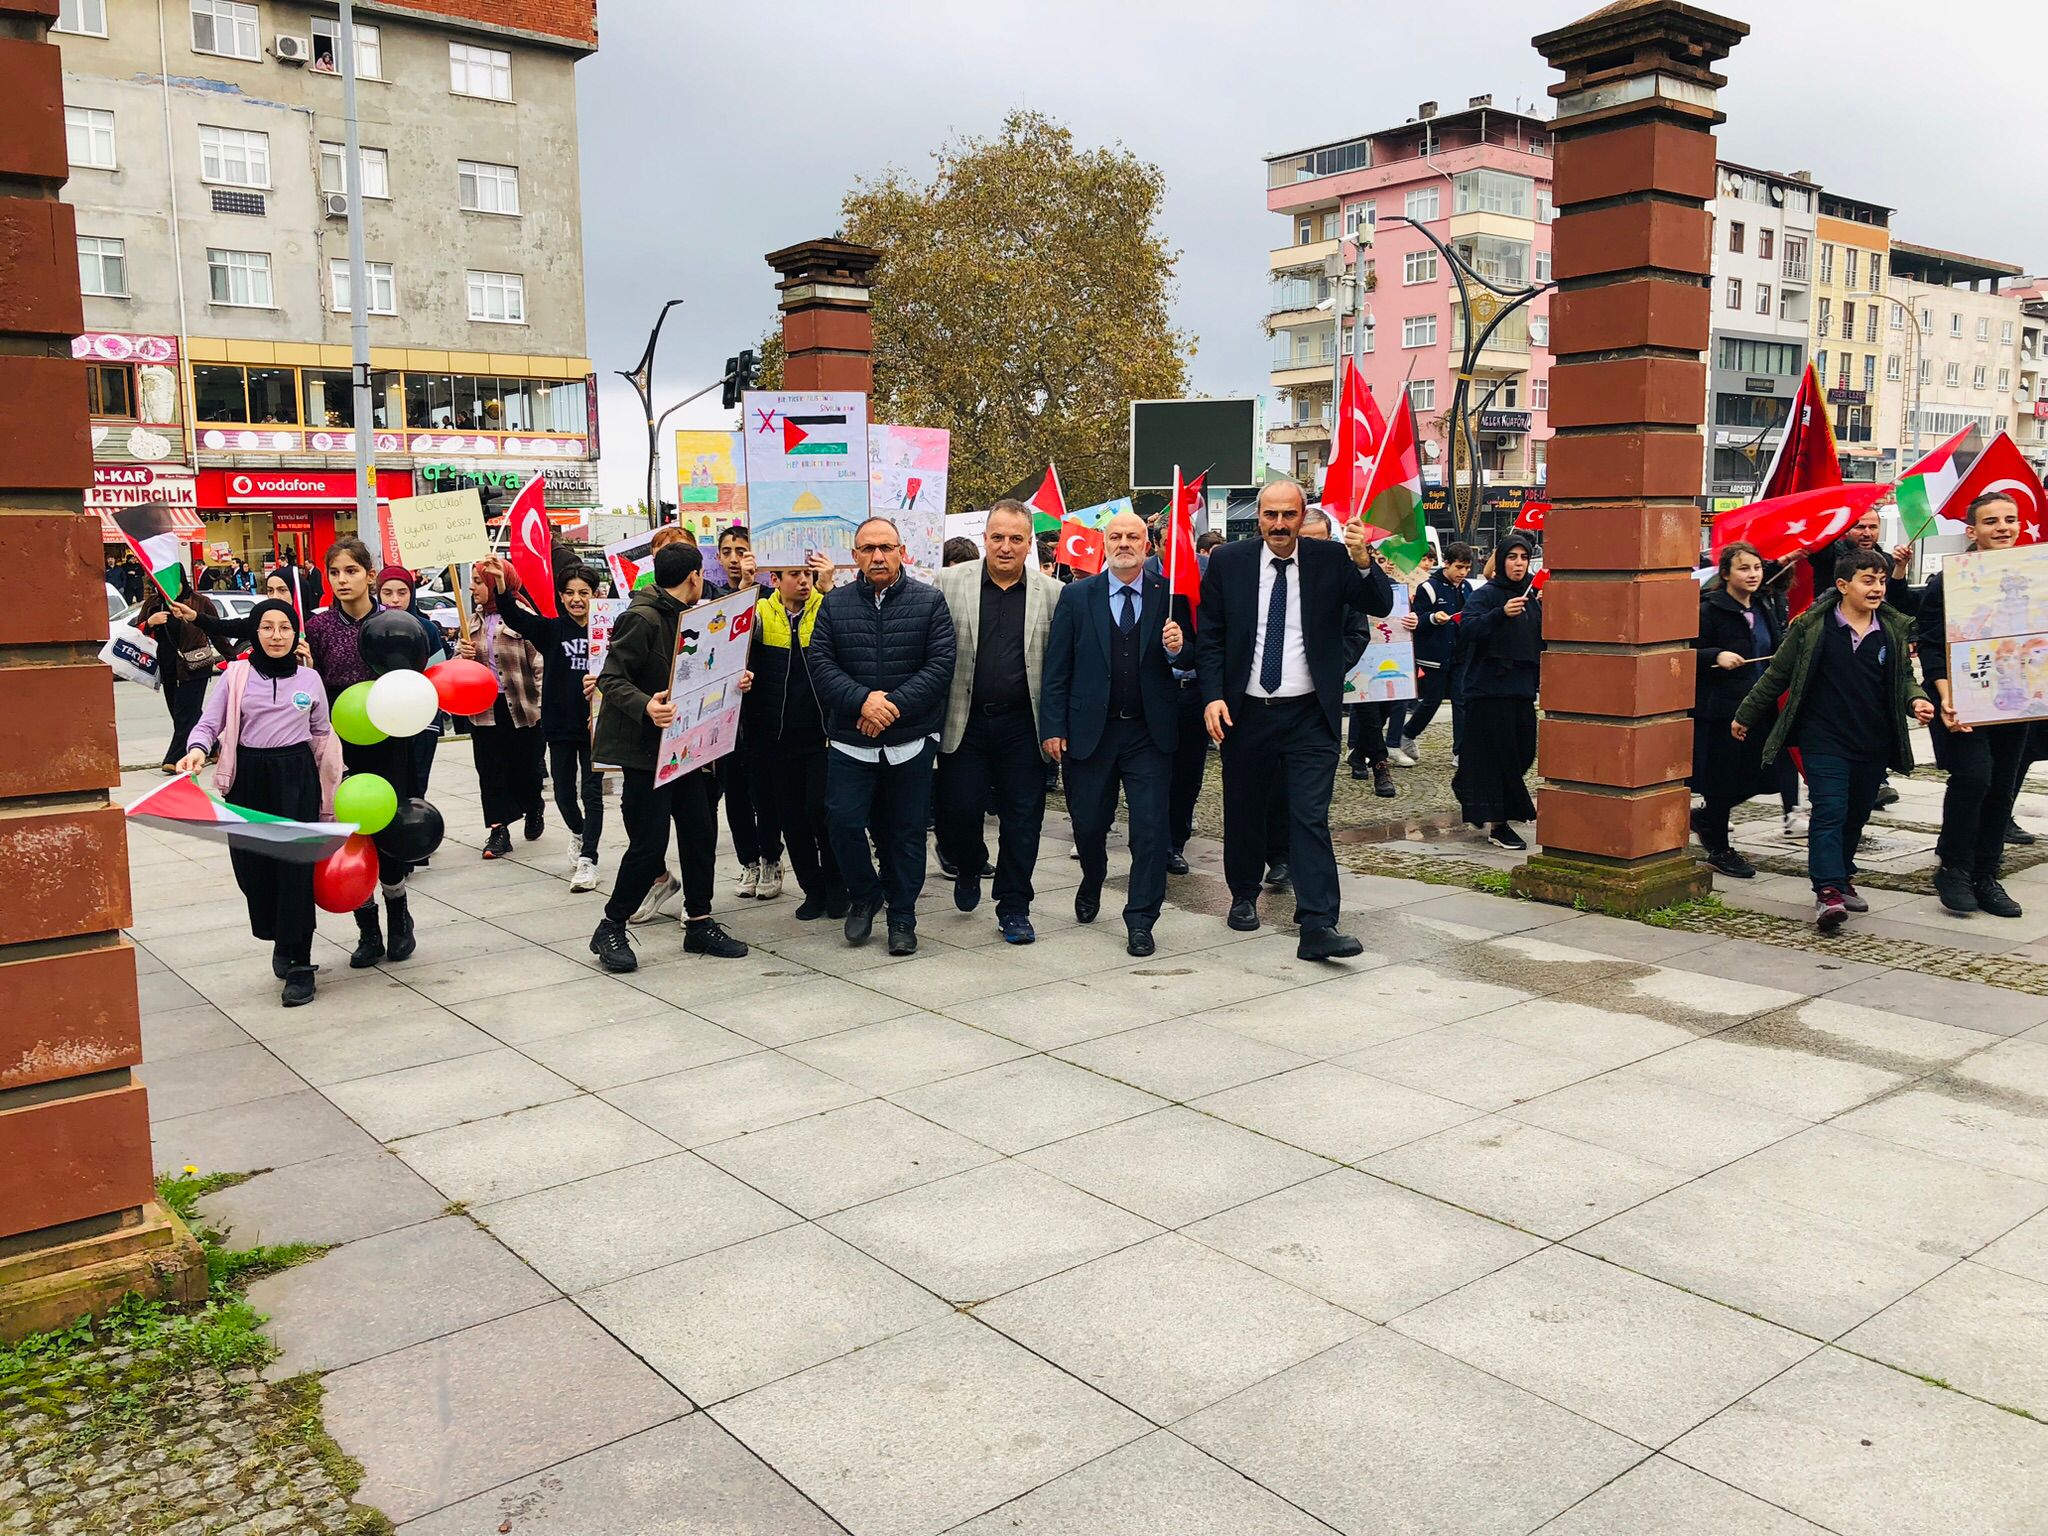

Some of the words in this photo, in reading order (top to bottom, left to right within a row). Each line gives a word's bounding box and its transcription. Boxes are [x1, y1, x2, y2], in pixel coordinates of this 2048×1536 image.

[94, 470, 147, 482] N-KAR
[569, 469, 580, 478] 66
[257, 478, 326, 491] vodafone
[525, 480, 592, 490] ANTACILIK
[92, 487, 193, 502] PEYNİRCİLİK
[1422, 499, 1445, 510] ender
